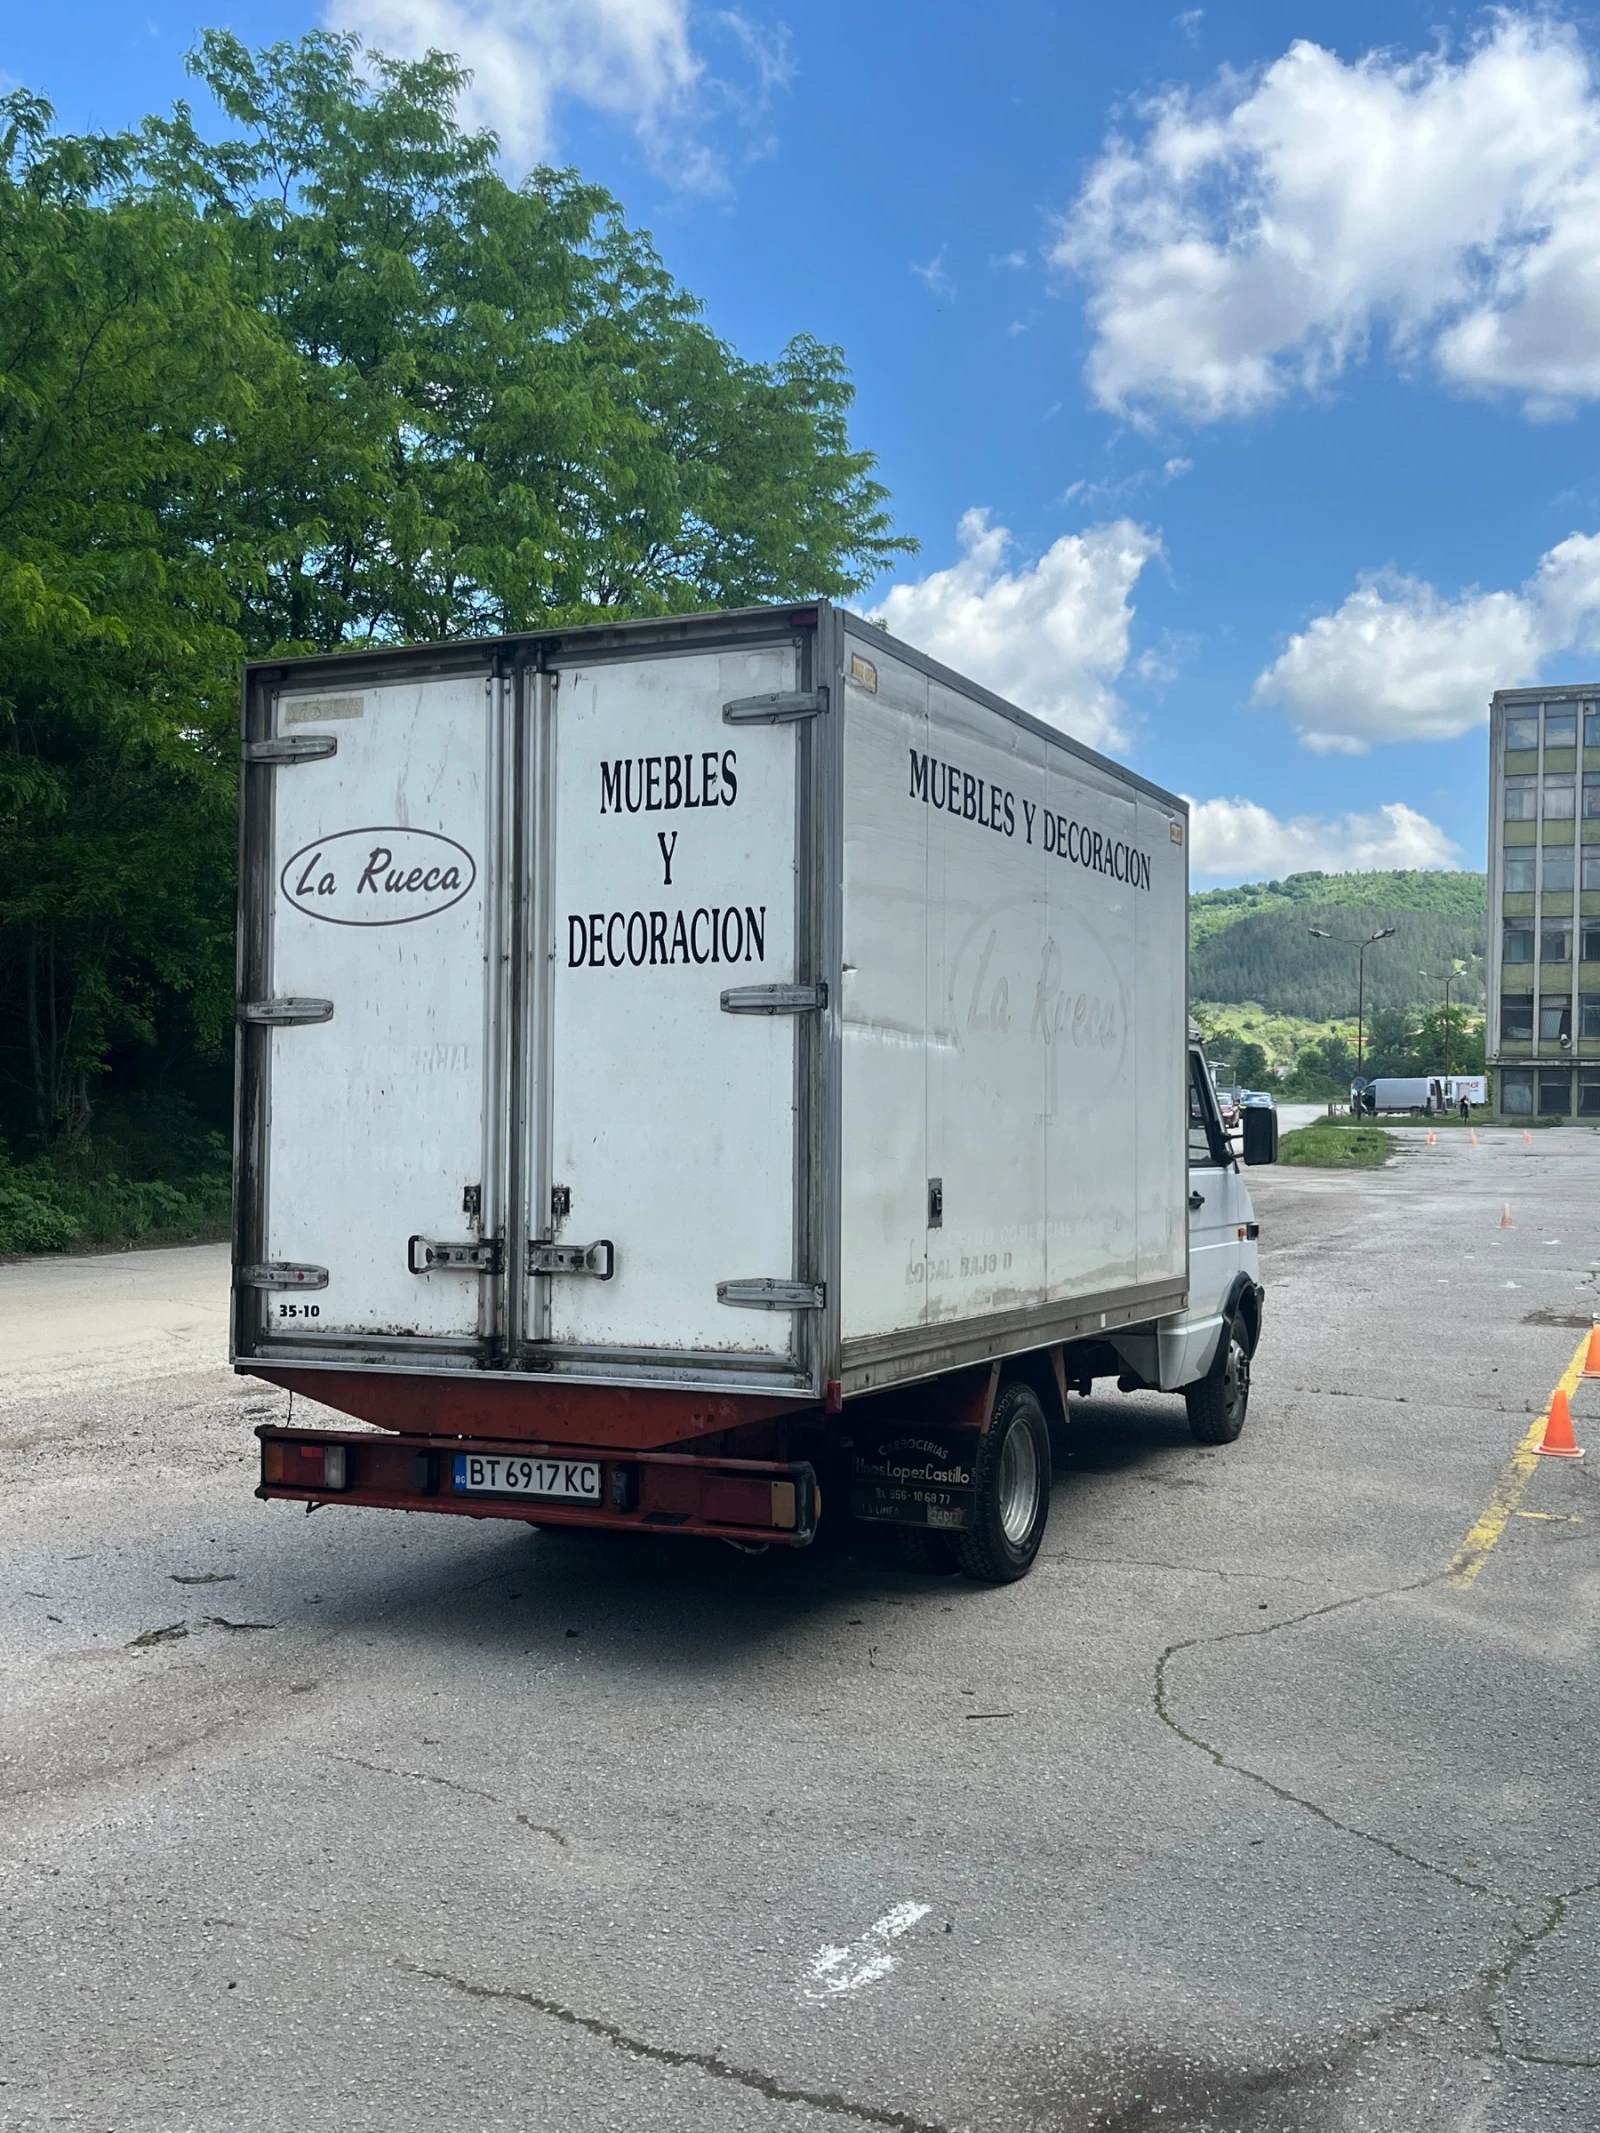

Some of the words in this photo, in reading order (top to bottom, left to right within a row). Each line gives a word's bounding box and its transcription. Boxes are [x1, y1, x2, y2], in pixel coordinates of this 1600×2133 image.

[600, 749, 738, 814] MUEBLES
[909, 748, 1015, 837] MUEBLES
[1022, 799, 1037, 845] Y
[1043, 808, 1151, 892] DECORACION
[295, 852, 337, 896] La
[357, 847, 462, 895] Rueca
[657, 831, 678, 885] Y
[568, 906, 766, 968] DECORACION
[967, 928, 1010, 1034] La
[1030, 936, 1117, 1049] Rueca
[905, 1259, 953, 1286] LOCAL
[960, 1253, 998, 1277] BAJO
[279, 1304, 320, 1318] 35-10
[878, 1438, 949, 1460] CARROCERIAS
[455, 1475, 466, 1484] BG
